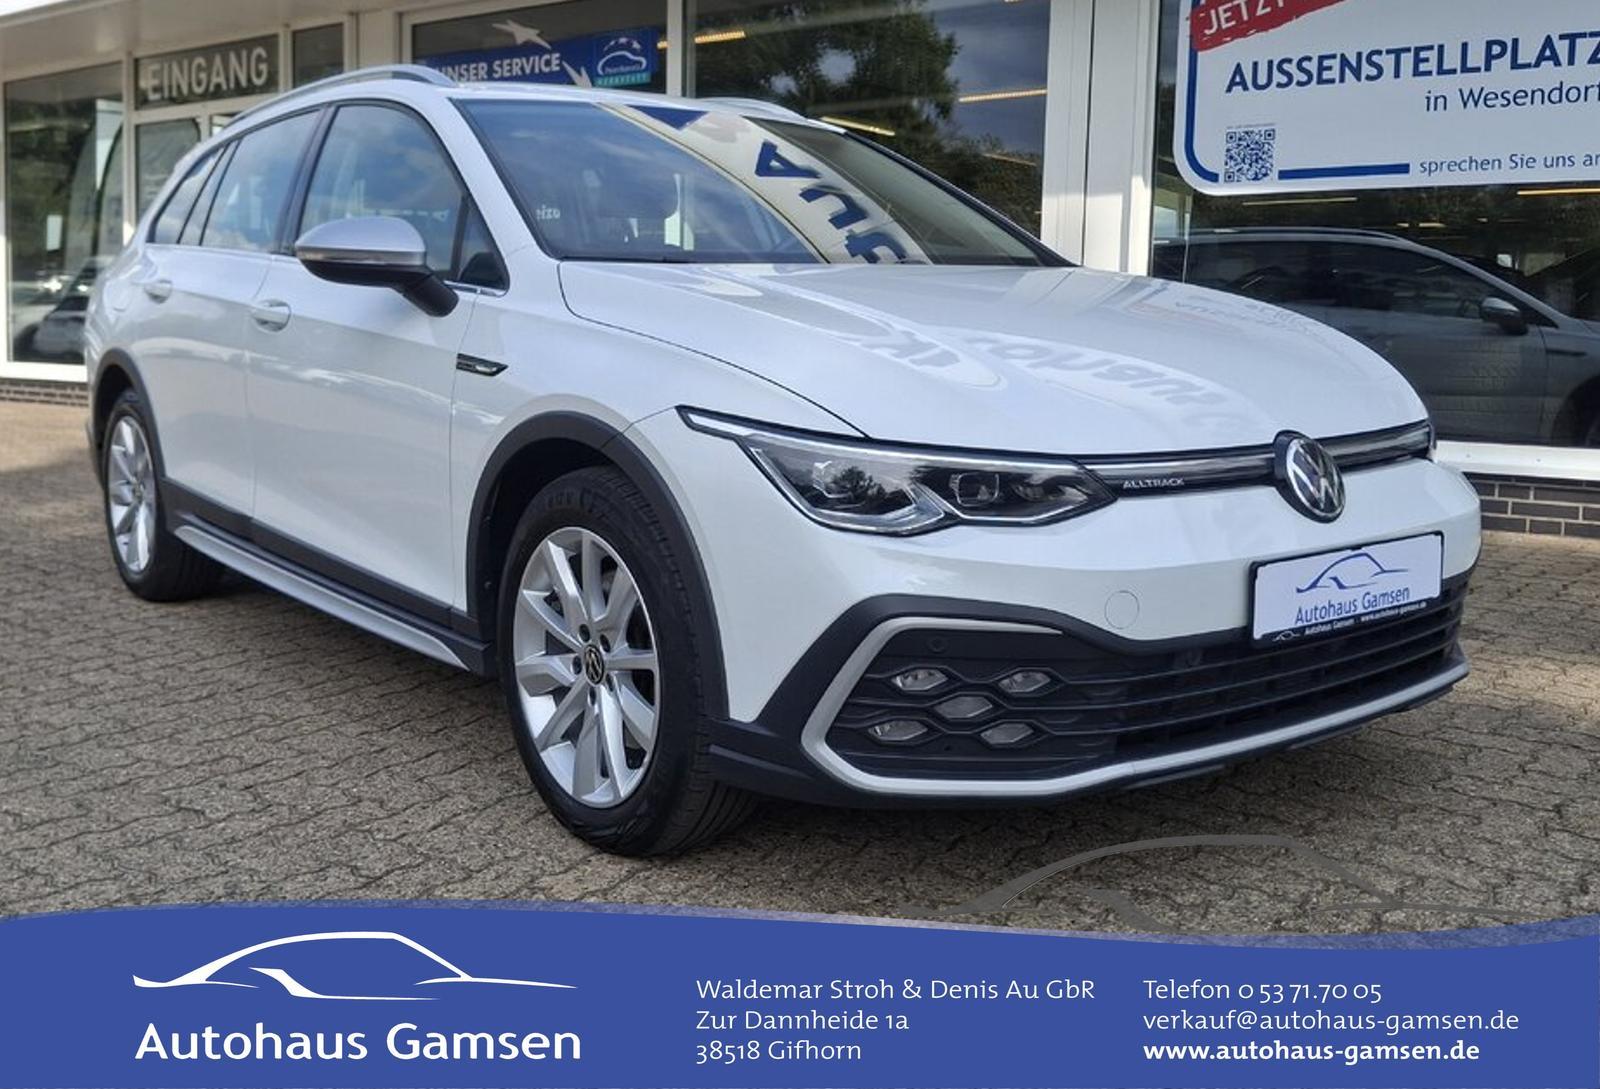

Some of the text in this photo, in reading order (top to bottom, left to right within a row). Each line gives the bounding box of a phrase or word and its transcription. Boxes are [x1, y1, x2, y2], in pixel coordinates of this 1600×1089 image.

[147, 46, 268, 101] EINGANG
[492, 53, 561, 78] SERVICE
[1425, 90, 1448, 112] in
[1419, 156, 1502, 176] sprechen
[1509, 154, 1537, 170] Sie
[1543, 154, 1576, 168] uns
[1122, 478, 1185, 490] ALLTRACK
[1295, 587, 1410, 624] Autohaus Gamsen
